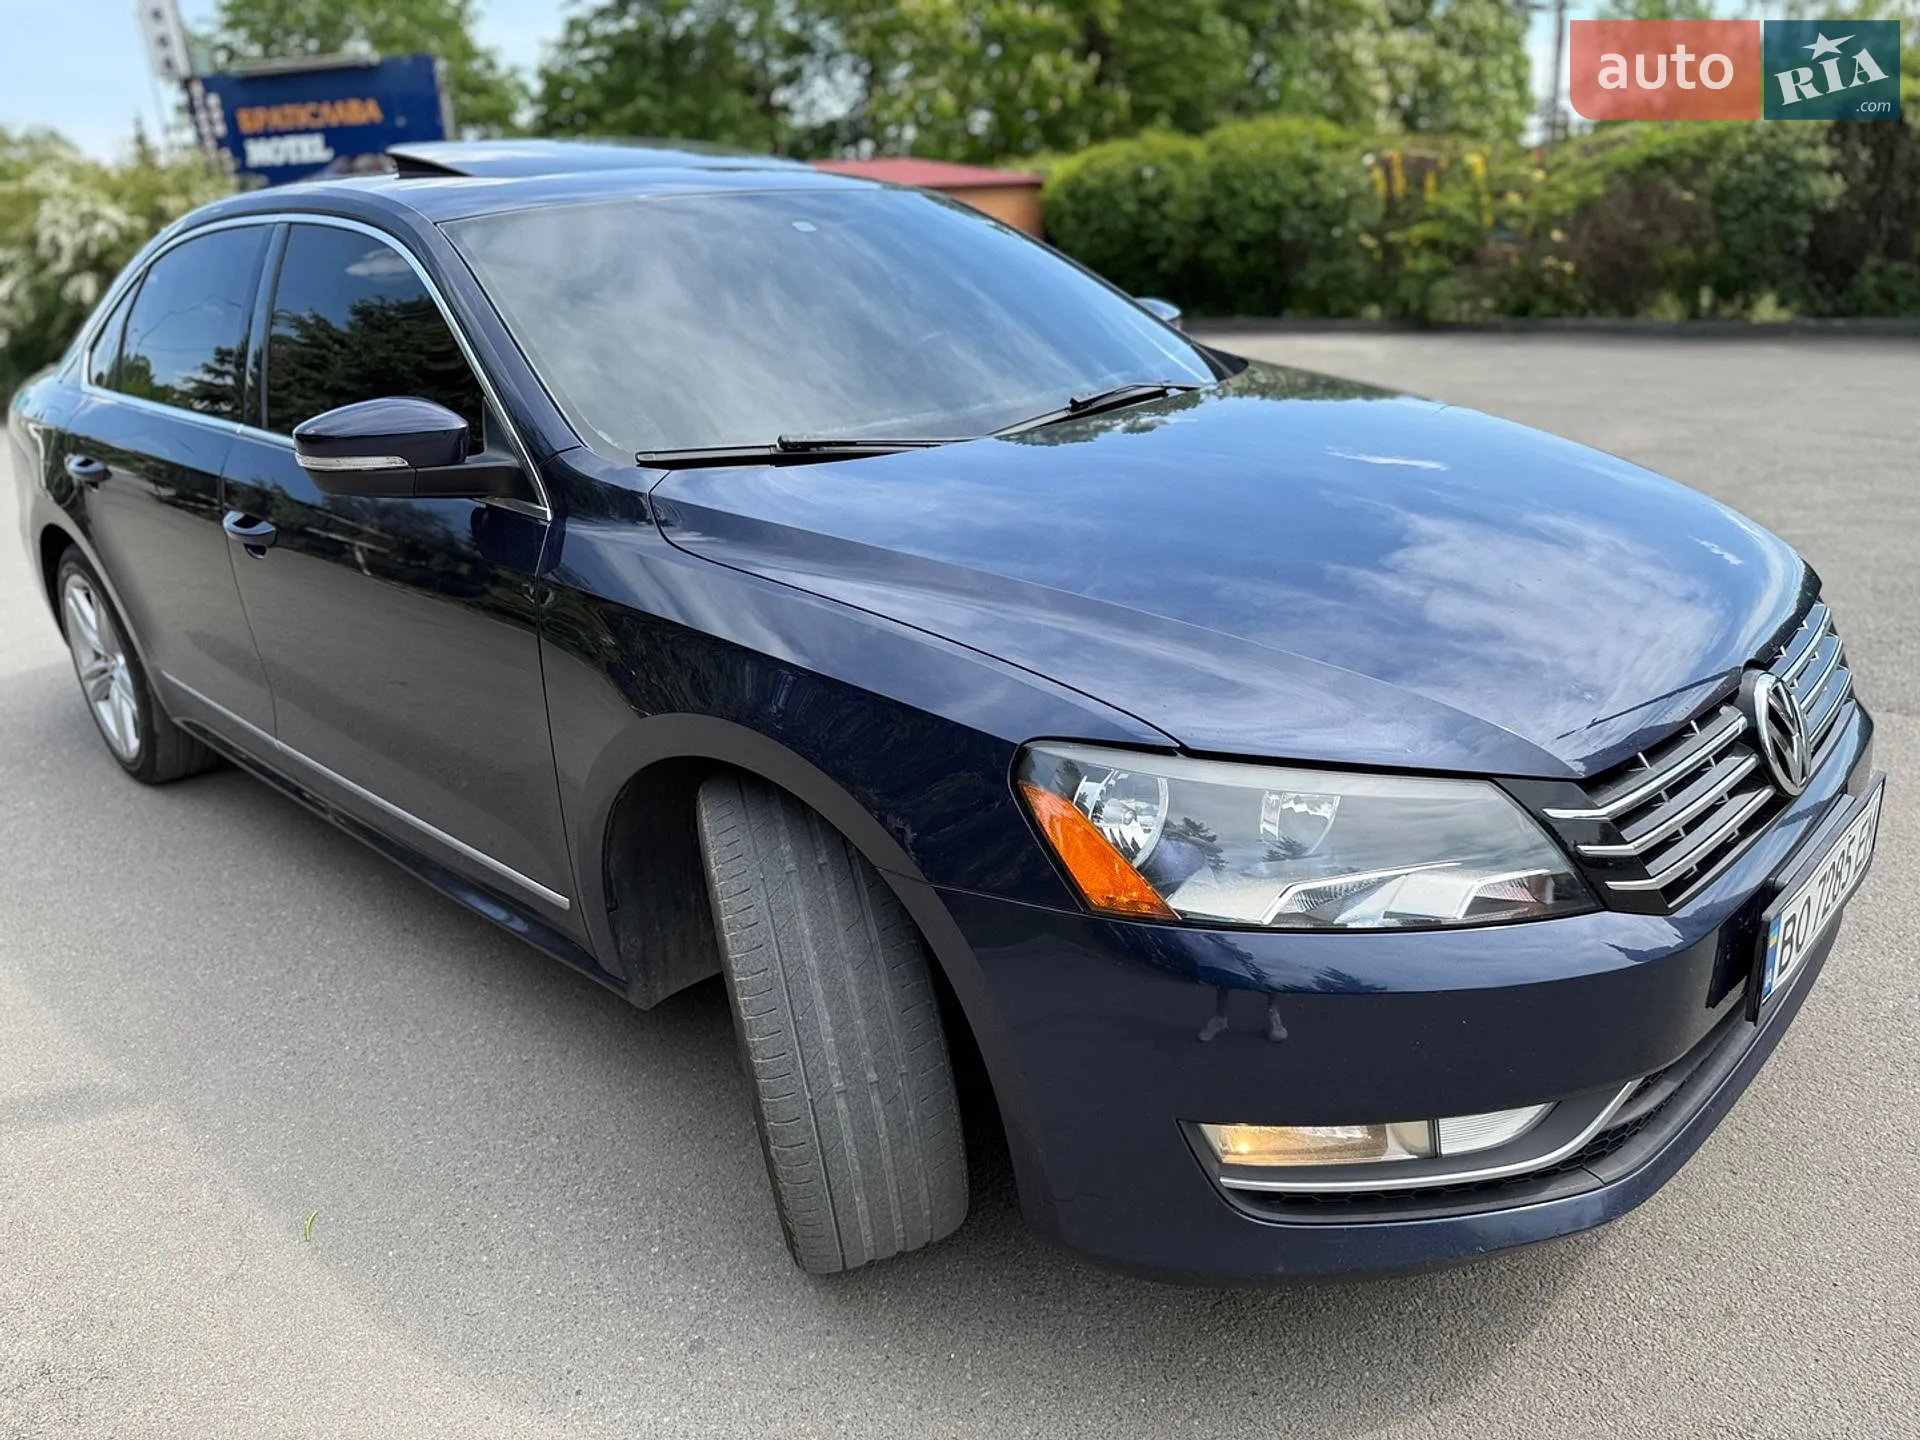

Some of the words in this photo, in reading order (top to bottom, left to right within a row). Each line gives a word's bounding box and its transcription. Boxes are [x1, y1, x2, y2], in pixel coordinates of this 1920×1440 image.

[244, 133, 334, 168] MOTEL
[1777, 895, 1811, 977] BO
[1812, 835, 1856, 932] 7285
